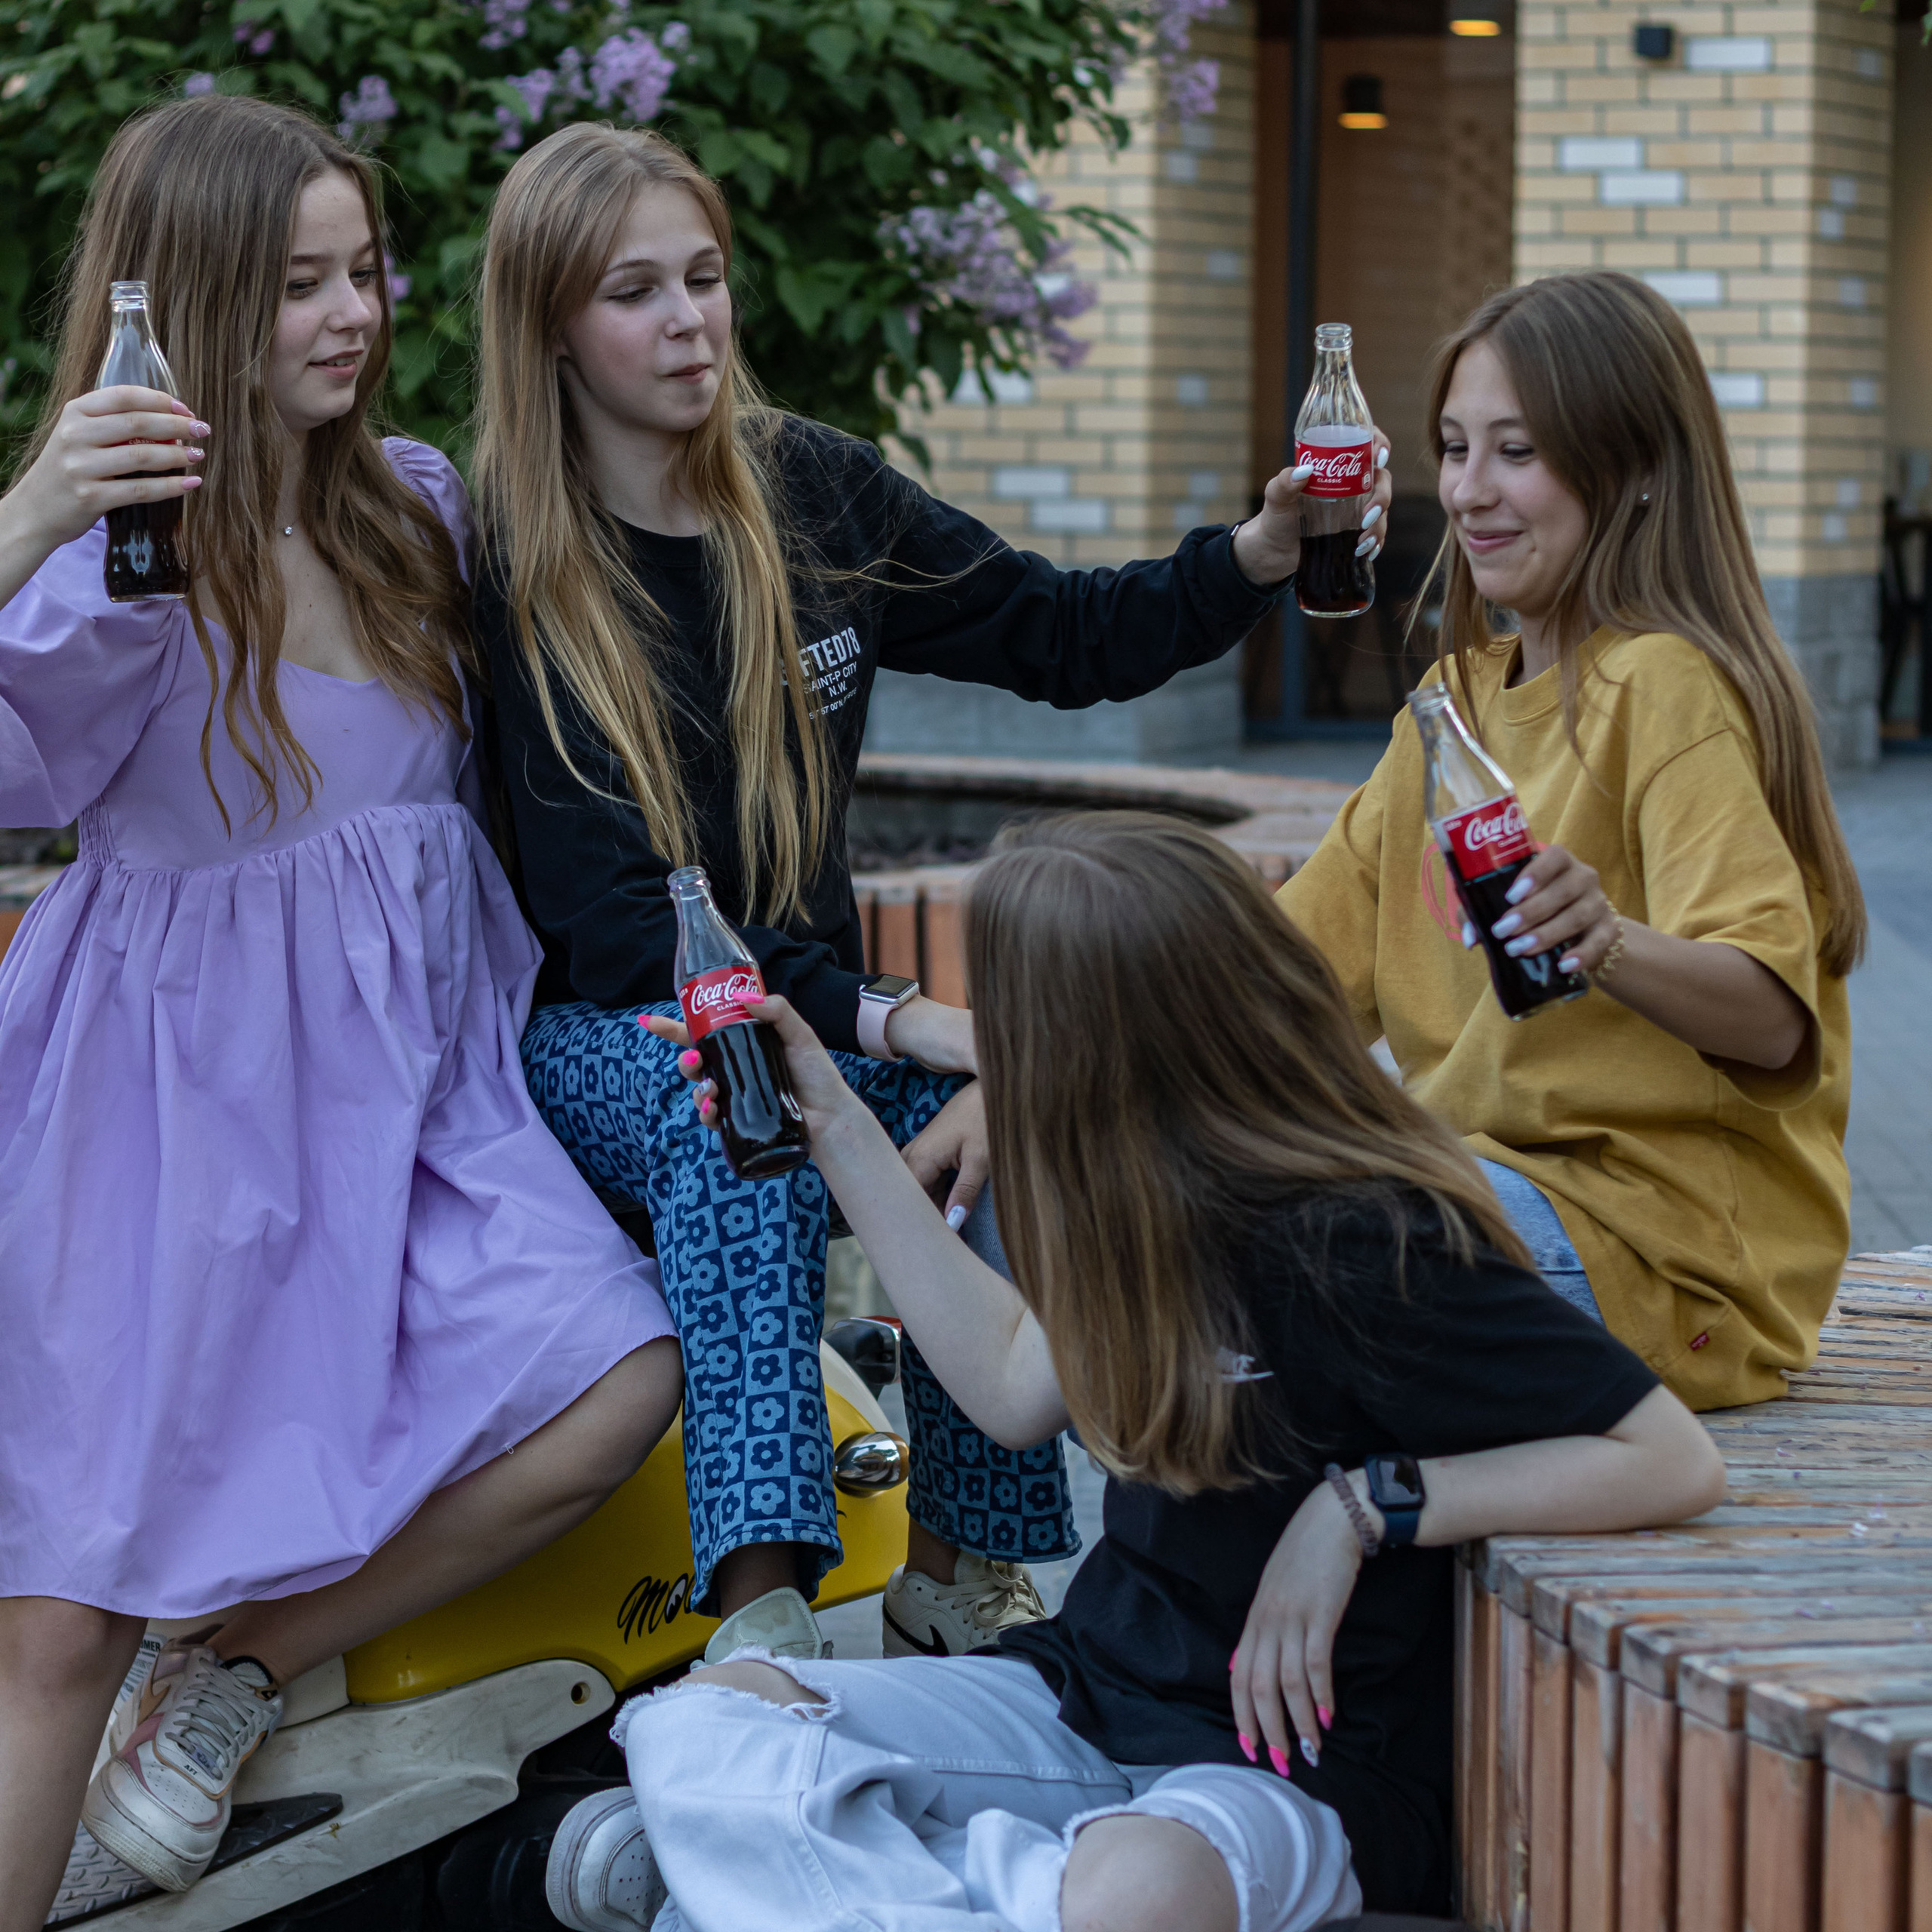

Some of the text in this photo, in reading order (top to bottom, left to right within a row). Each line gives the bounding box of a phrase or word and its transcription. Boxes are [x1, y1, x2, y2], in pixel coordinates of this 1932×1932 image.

[780, 626, 861, 686] FTED78
[842, 661, 857, 678] CITY
[829, 680, 847, 697] N.W.
